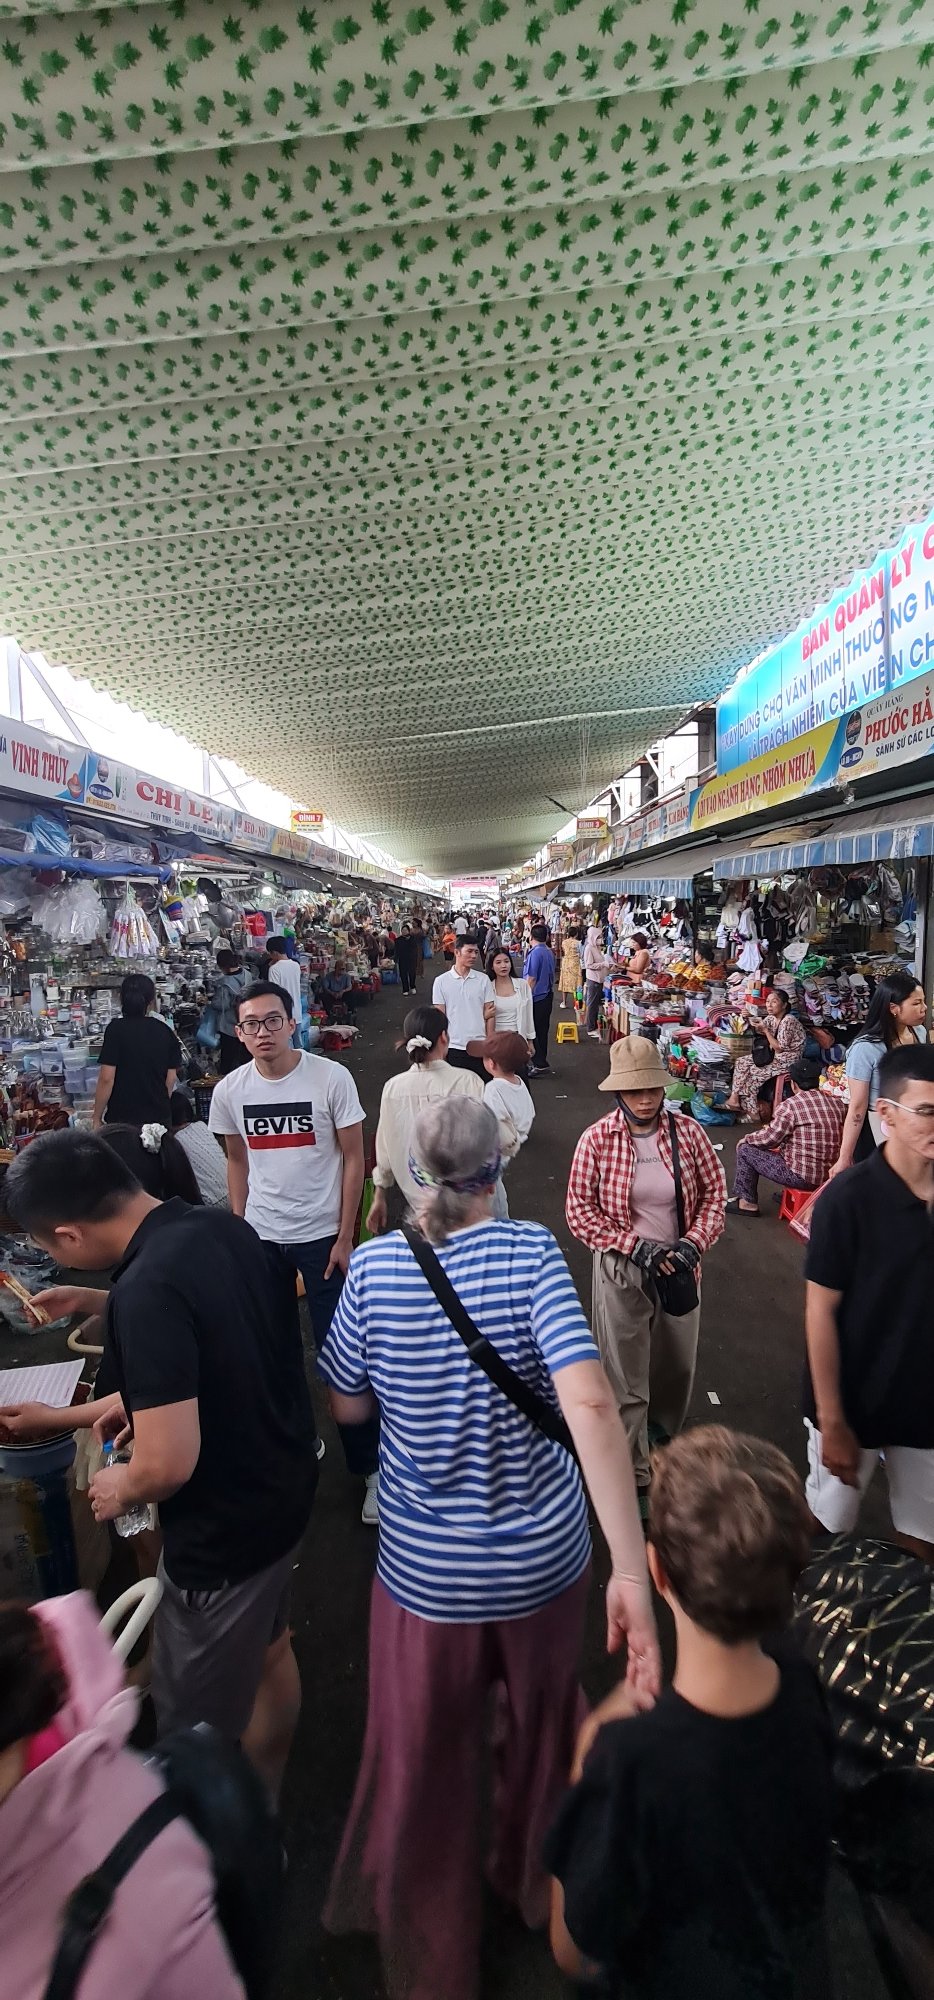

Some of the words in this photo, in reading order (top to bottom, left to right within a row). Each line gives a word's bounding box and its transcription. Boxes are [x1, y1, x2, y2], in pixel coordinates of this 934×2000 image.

[802, 617, 830, 660] BAN
[834, 569, 884, 633] QUẢN
[891, 537, 916, 589] LÝ
[763, 693, 783, 719] CHỢ
[786, 675, 807, 706] VĂN
[811, 648, 841, 690] MINH
[845, 593, 917, 664] THƯƠNG
[760, 723, 788, 755] TRÁCH
[829, 677, 858, 716] CỦA
[862, 649, 903, 696] VIÊN
[884, 693, 904, 710] HÀNG
[864, 705, 909, 746] PHƯỚC
[875, 741, 895, 758] SÀNH
[896, 734, 906, 750] SỨ
[907, 730, 923, 746] CÁC
[11, 740, 39, 777] VINH
[136, 781, 182, 815] CHỊ
[697, 791, 706, 819] LỐI
[706, 790, 717, 815] VÀO
[717, 782, 739, 812] NGÀNH
[740, 773, 761, 802] HÀNG
[762, 758, 786, 794] NHÔM
[788, 746, 816, 787] NHỰA
[298, 813, 316, 821] ĐÌNH
